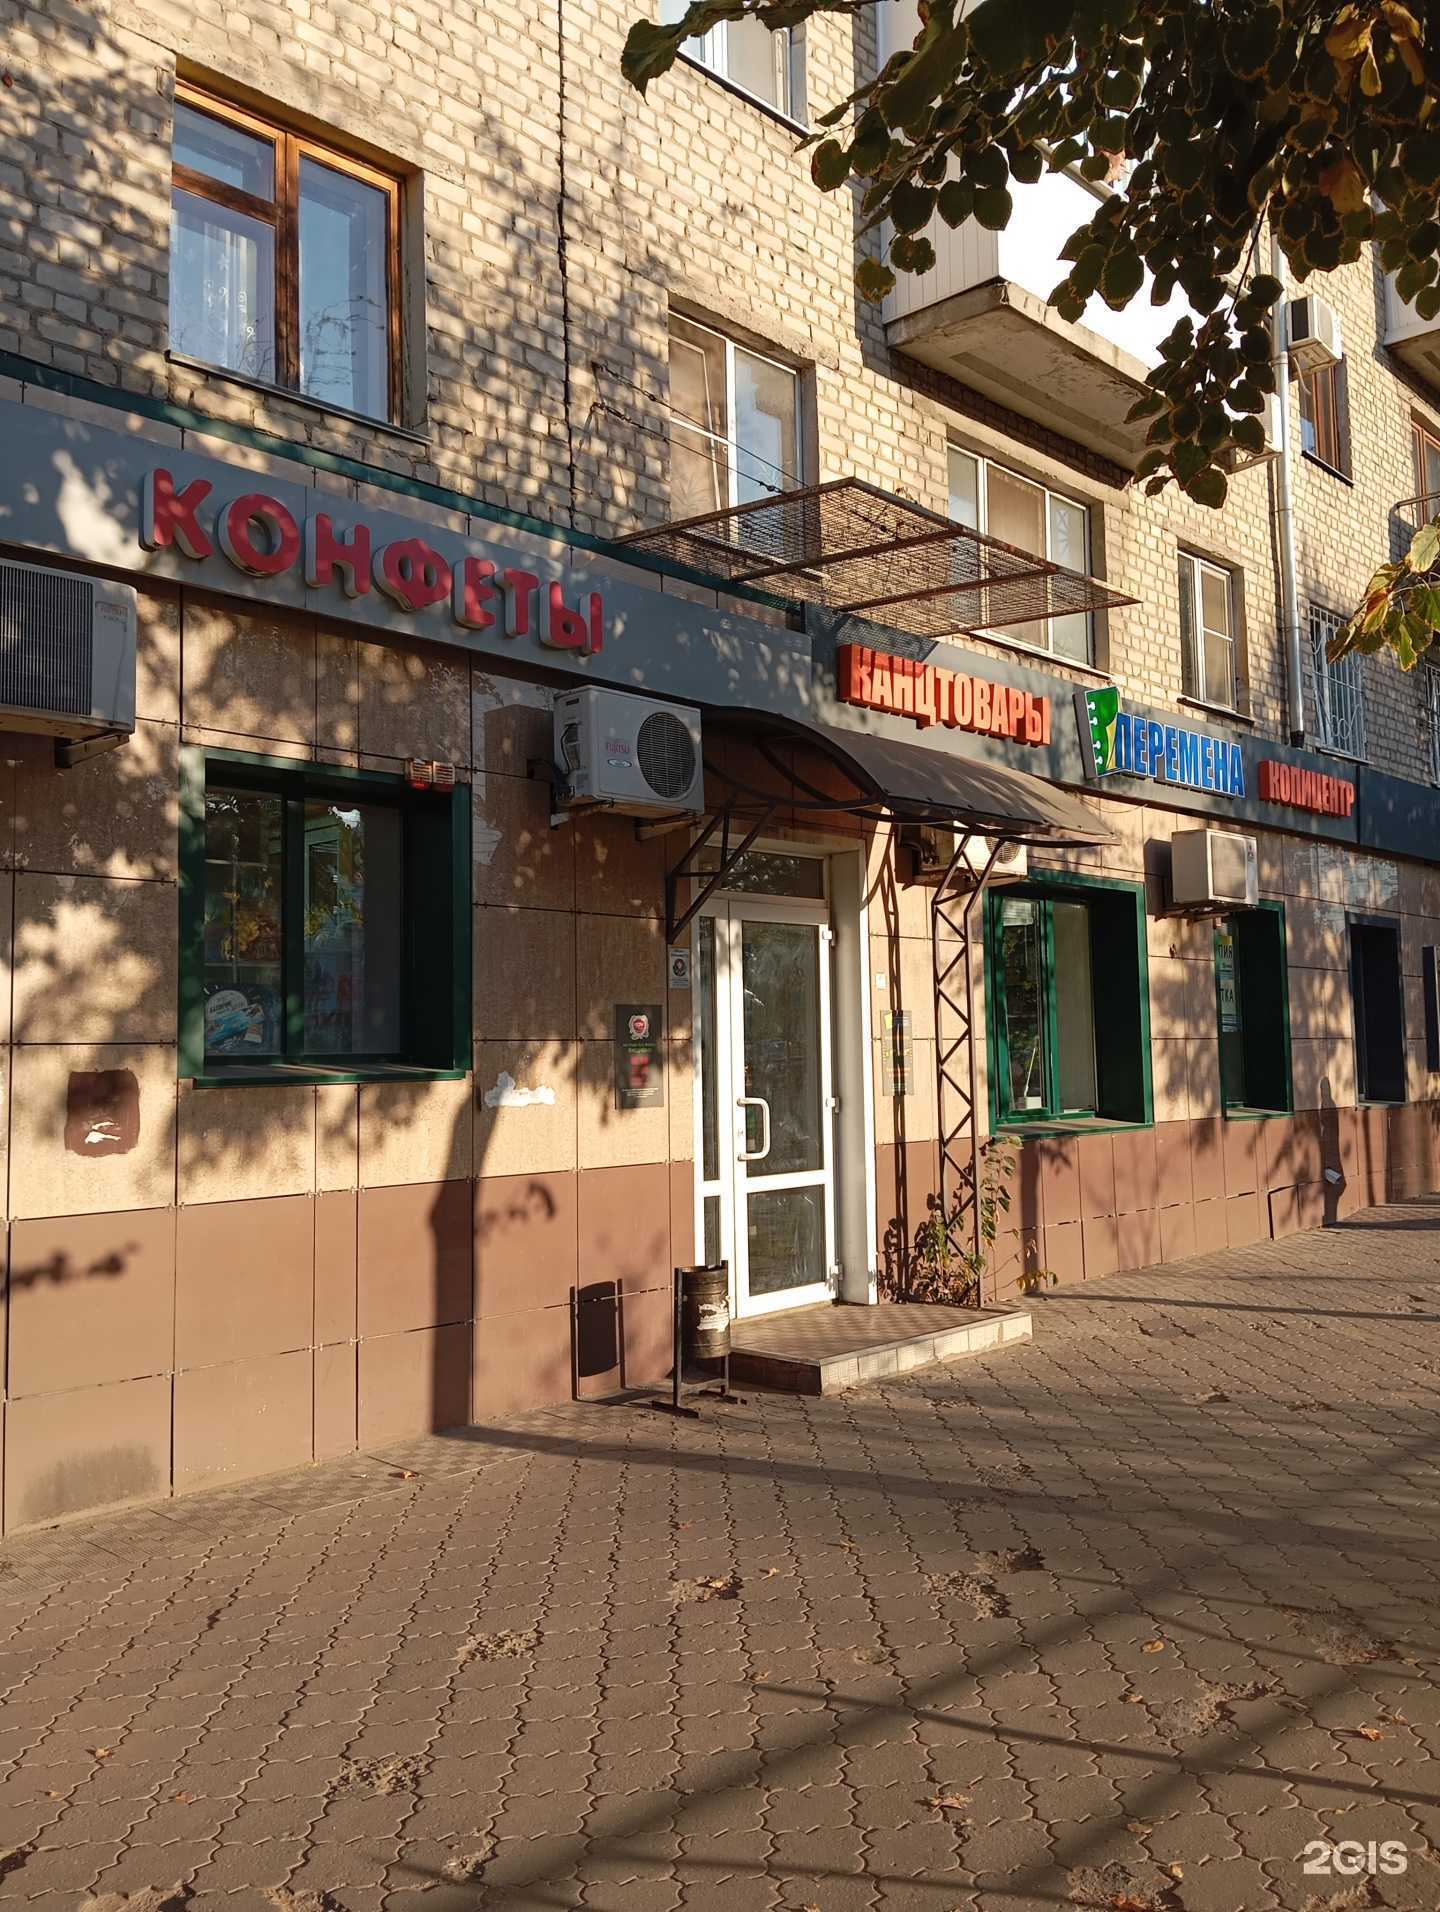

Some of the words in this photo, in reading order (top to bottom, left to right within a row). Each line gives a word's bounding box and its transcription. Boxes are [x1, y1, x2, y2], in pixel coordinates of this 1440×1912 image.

[140, 467, 604, 655] КОНФЕТЫ
[845, 643, 1052, 746] КАНЦТОВАРЫ
[1115, 712, 1246, 799] ПЕРЕМЕНА
[1266, 760, 1356, 817] КОПИЦЕНТР
